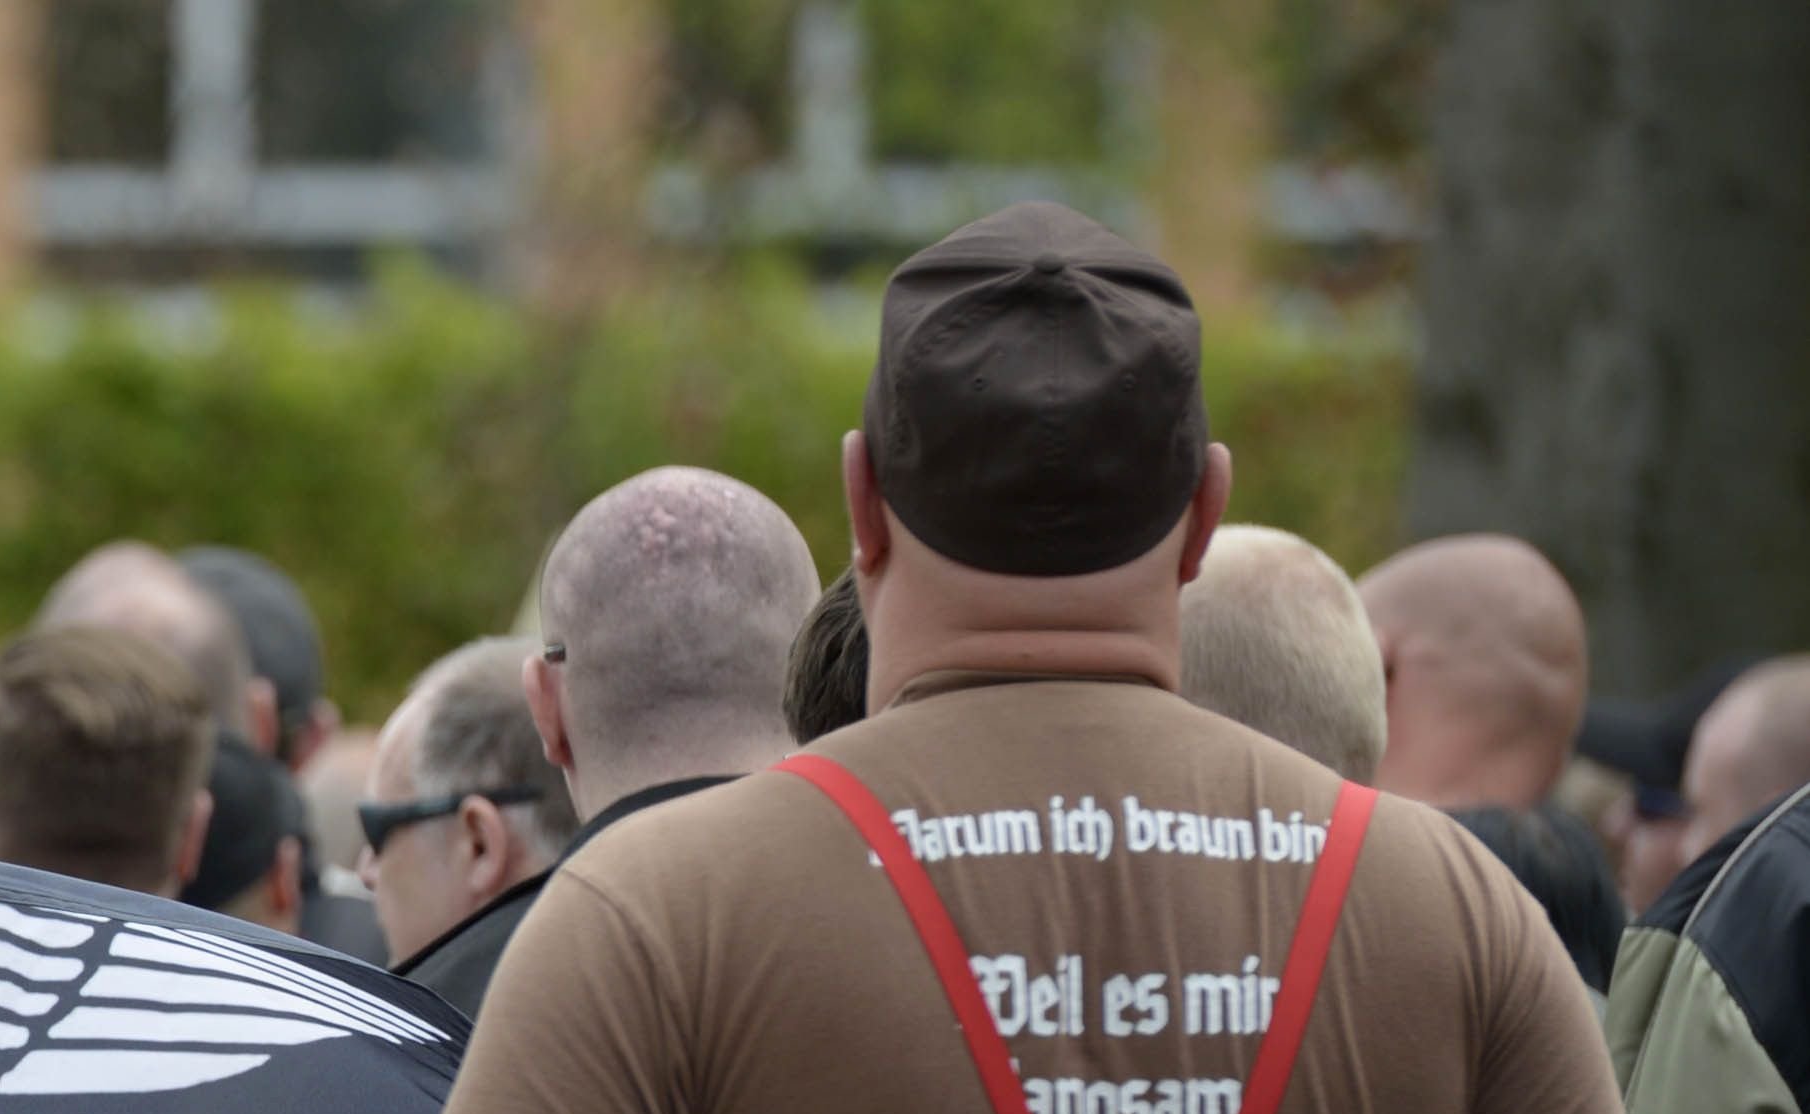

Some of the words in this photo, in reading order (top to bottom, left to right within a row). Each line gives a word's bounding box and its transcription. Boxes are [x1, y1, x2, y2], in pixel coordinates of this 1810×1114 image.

[1049, 795, 1114, 862] ich
[1122, 795, 1255, 861] braun
[1258, 808, 1331, 864] bin
[1102, 973, 1169, 1037] es
[1183, 954, 1281, 1036] mir
